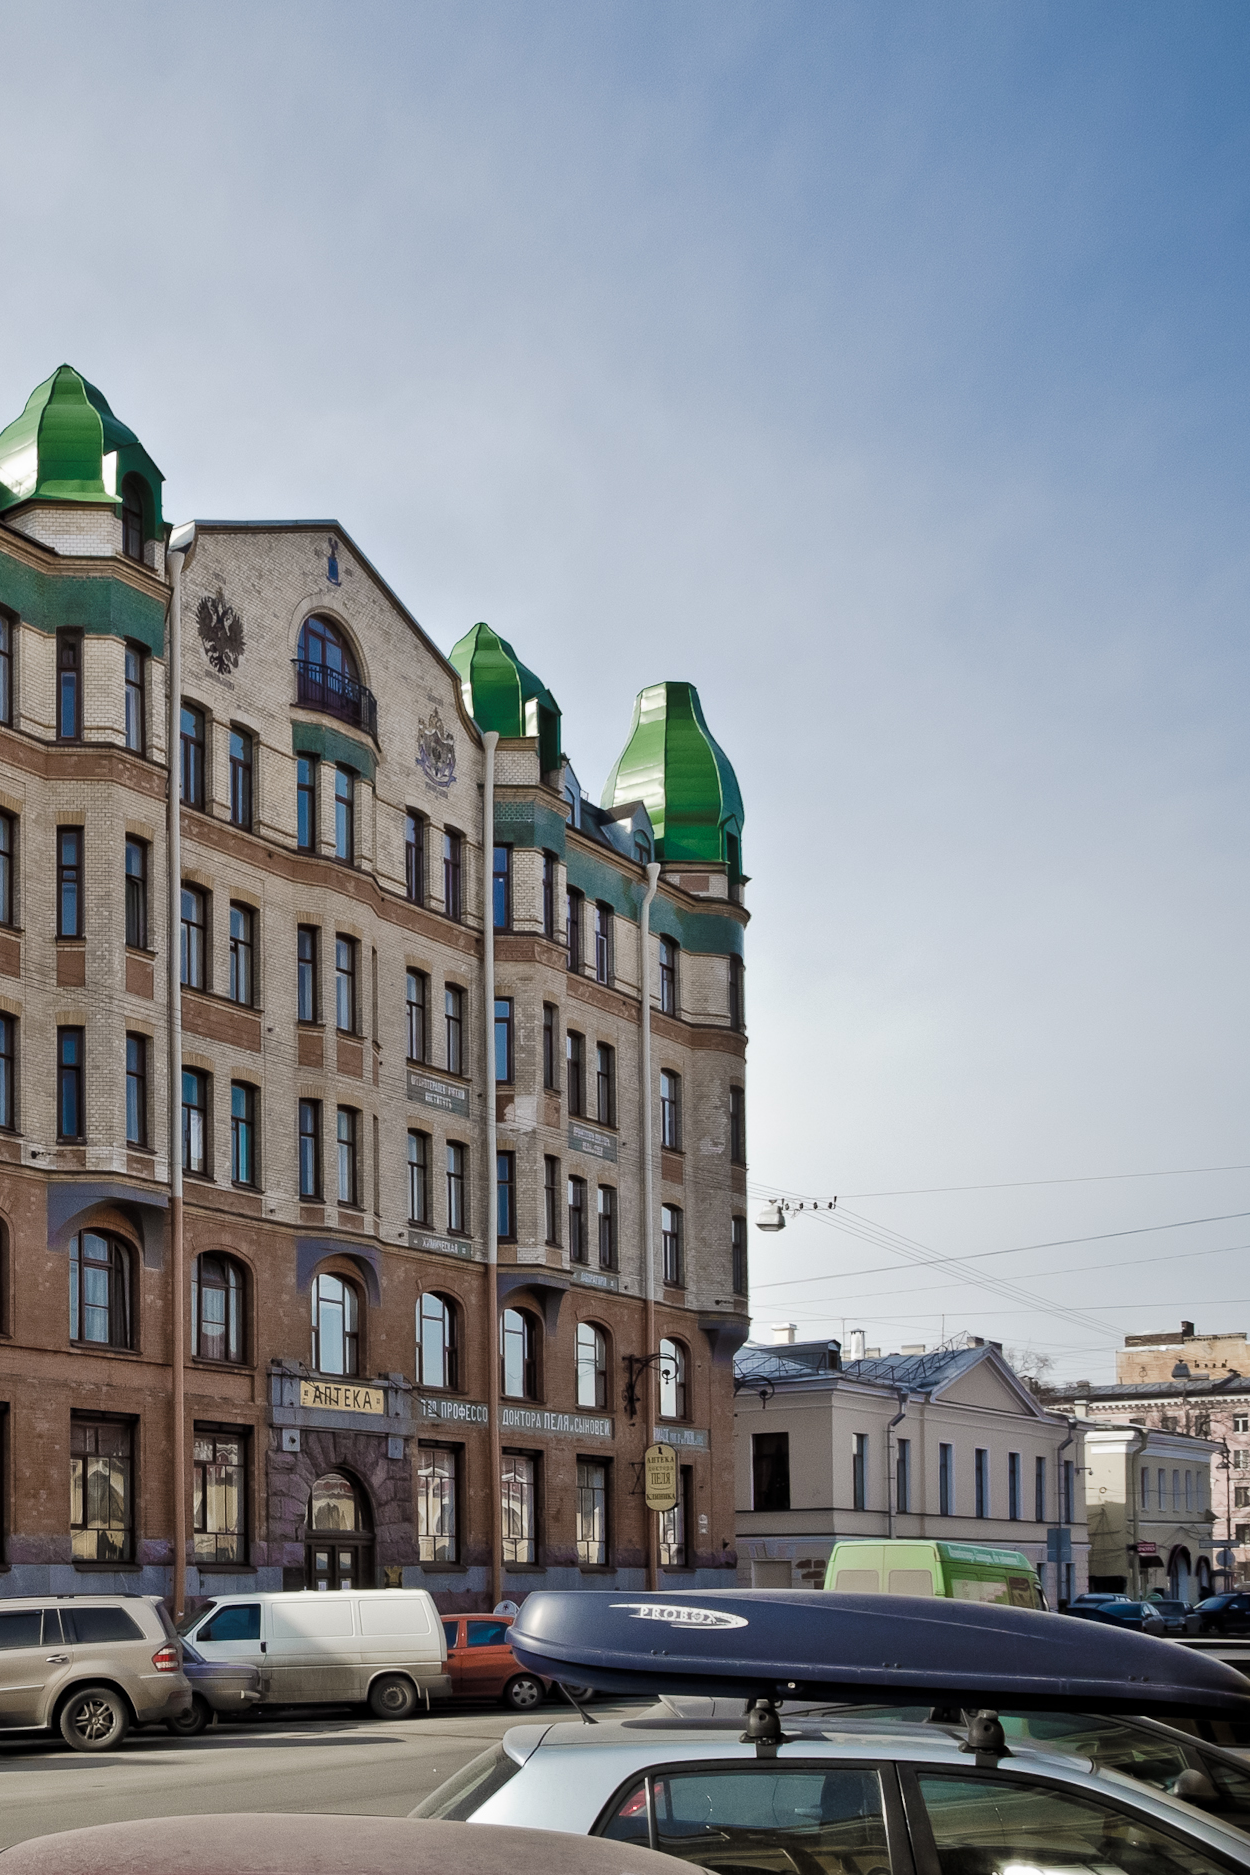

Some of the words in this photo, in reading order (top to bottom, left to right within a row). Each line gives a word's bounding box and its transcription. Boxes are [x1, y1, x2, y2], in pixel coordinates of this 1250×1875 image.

[312, 1385, 373, 1409] АПТЕКА
[441, 1401, 488, 1422] ПРОФЕССО
[502, 1409, 541, 1428] ДОКТОРА
[544, 1412, 569, 1431] ПЕЛЯ
[574, 1417, 611, 1436] СЫНОВЕЙ
[647, 1456, 675, 1464] АПТЕКА
[651, 1472, 671, 1485] ПЕЛЯ
[646, 1493, 676, 1501] КЛИНИКА
